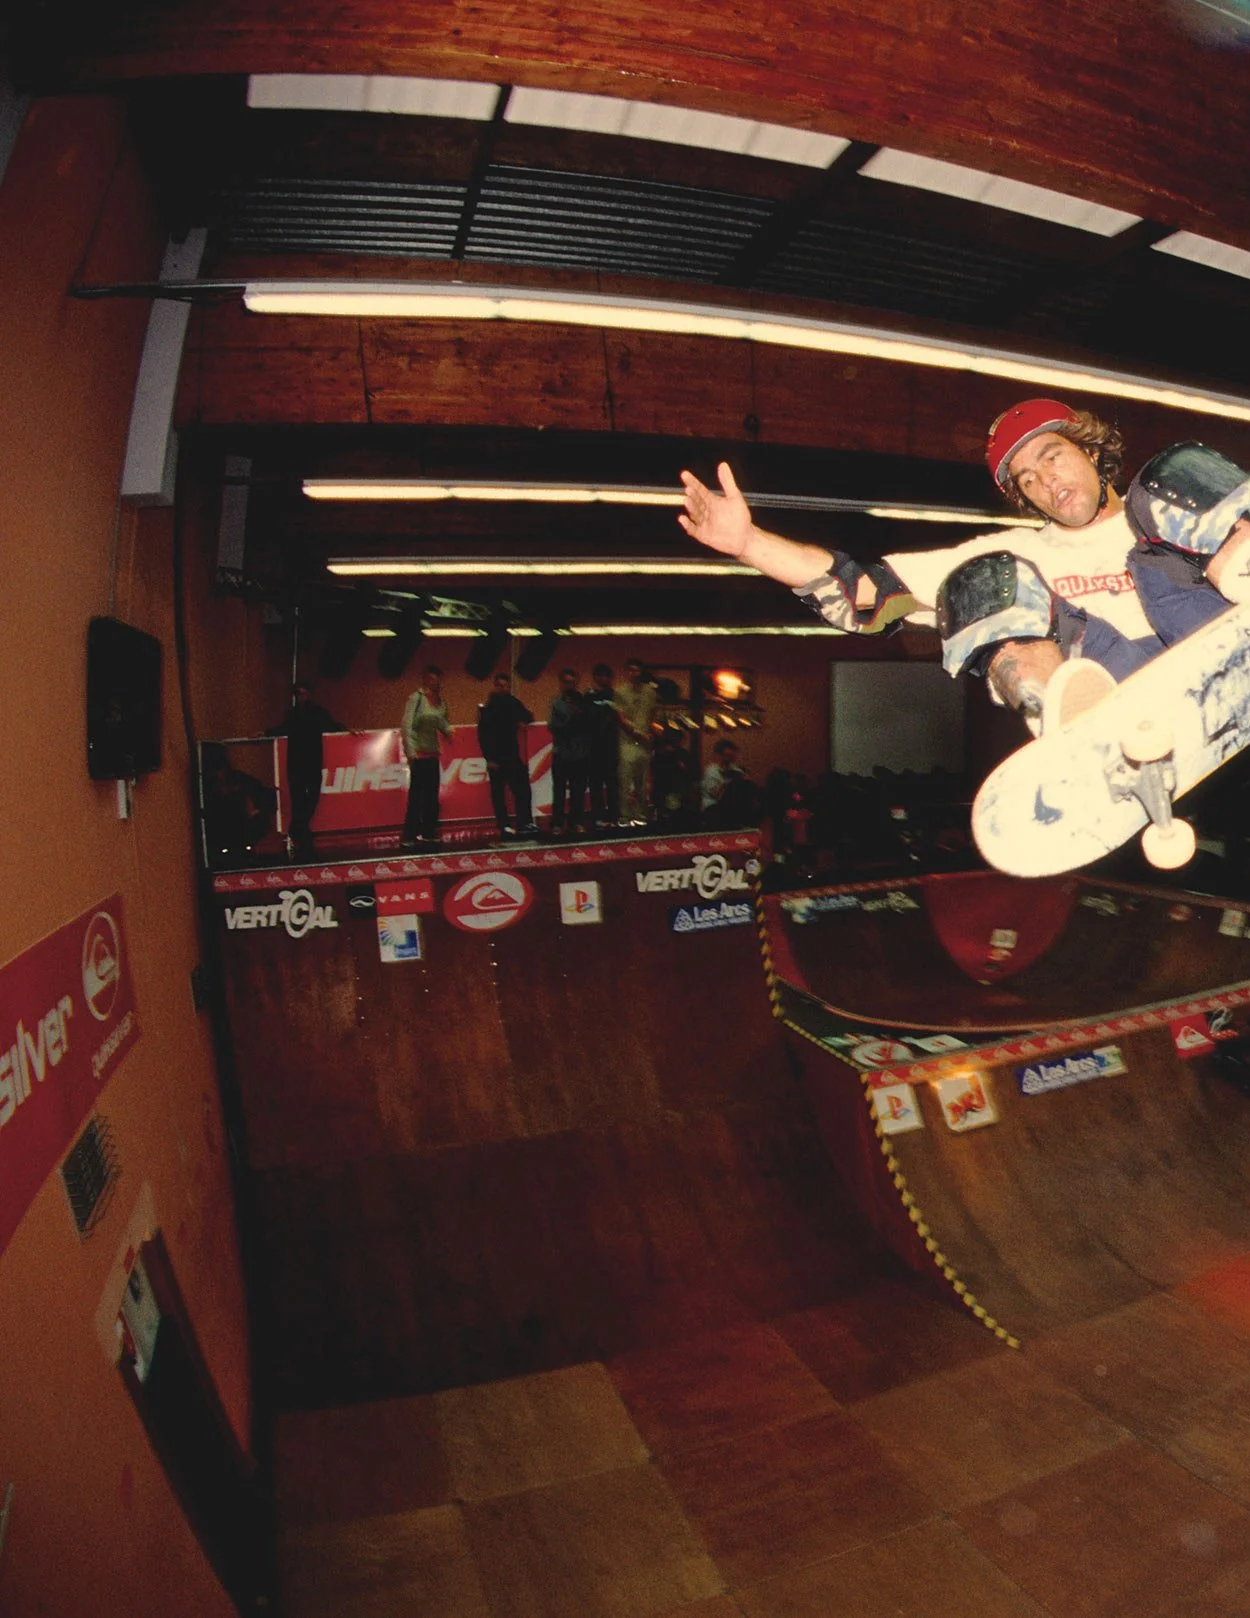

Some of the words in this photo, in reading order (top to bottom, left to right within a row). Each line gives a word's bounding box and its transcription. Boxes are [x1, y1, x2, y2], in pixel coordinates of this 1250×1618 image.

[1056, 574, 1135, 597] QUIKSI
[636, 854, 750, 899] VERTICAL
[378, 891, 429, 904] VANS
[224, 889, 339, 939] VERTICAL
[692, 905, 719, 922] Les
[719, 902, 752, 919] Arcs
